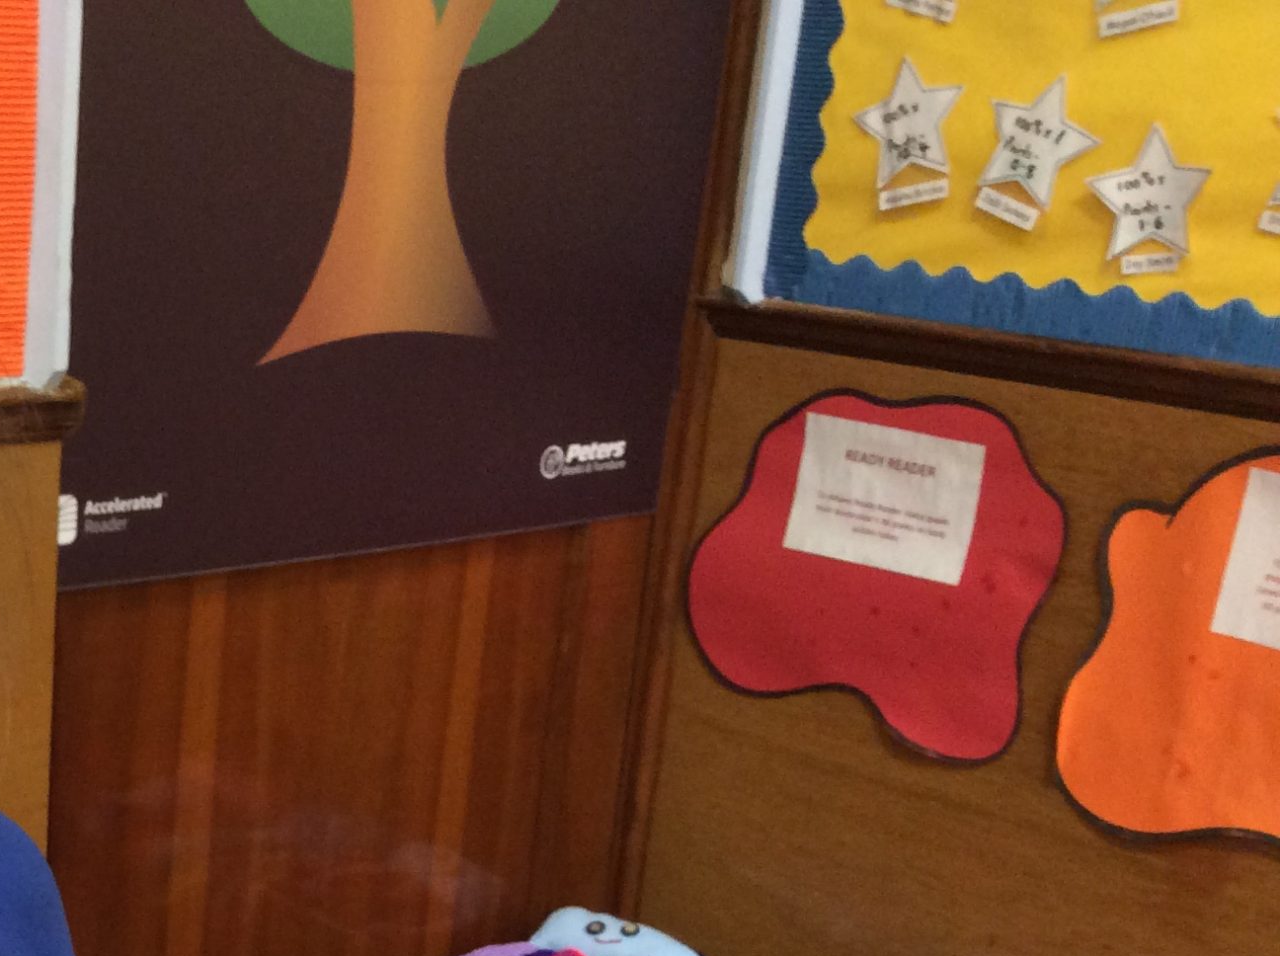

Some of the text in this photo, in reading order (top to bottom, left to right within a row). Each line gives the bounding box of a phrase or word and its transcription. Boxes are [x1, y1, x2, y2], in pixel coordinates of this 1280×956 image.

[565, 440, 627, 464] Peters
[845, 449, 937, 477] READY READER
[84, 492, 164, 515] Accelerated
